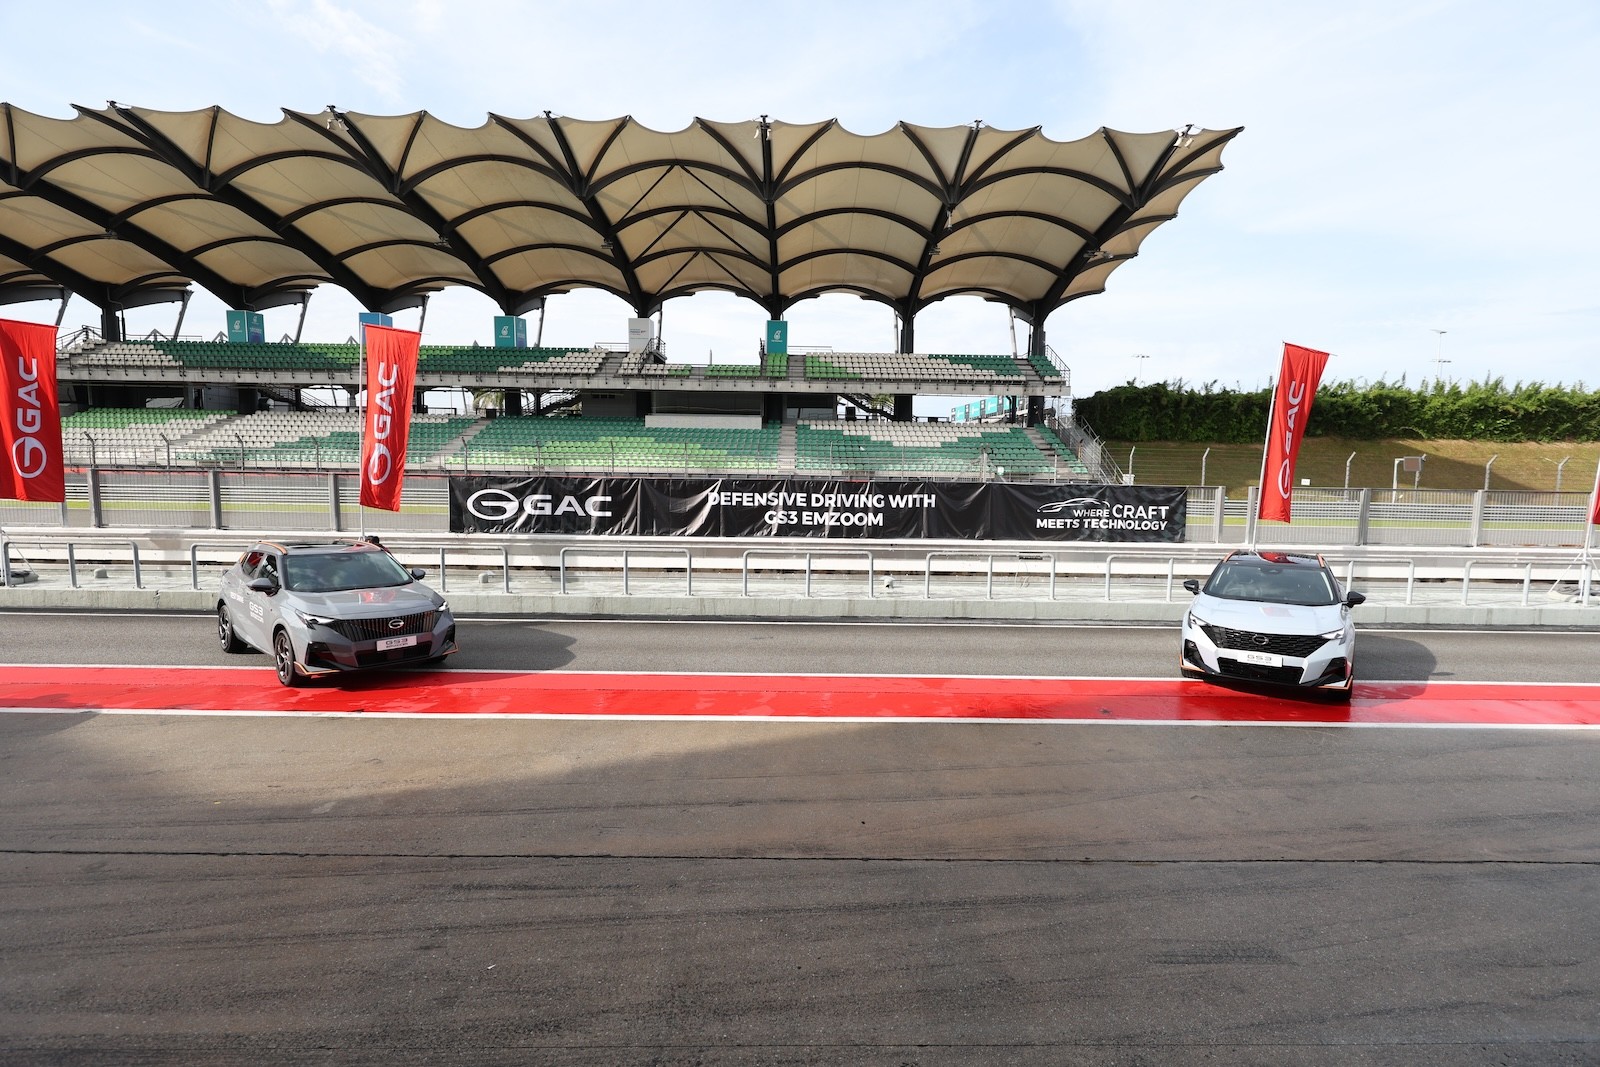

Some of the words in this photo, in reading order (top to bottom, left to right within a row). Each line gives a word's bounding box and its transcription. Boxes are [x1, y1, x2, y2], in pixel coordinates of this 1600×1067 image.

[17, 356, 41, 434] GAC
[374, 361, 399, 440] GAC
[523, 494, 612, 517] GAC
[708, 491, 807, 507] DEFENSIVE
[811, 493, 885, 508] DRIVING
[888, 494, 936, 508] WITH
[764, 510, 798, 525] GS3
[802, 511, 884, 526] EMZOOM
[1073, 509, 1110, 518] WHERE
[1112, 504, 1170, 520] CRAFT
[1036, 518, 1080, 529] MEETS
[1083, 518, 1168, 531] TECHNOLOGY
